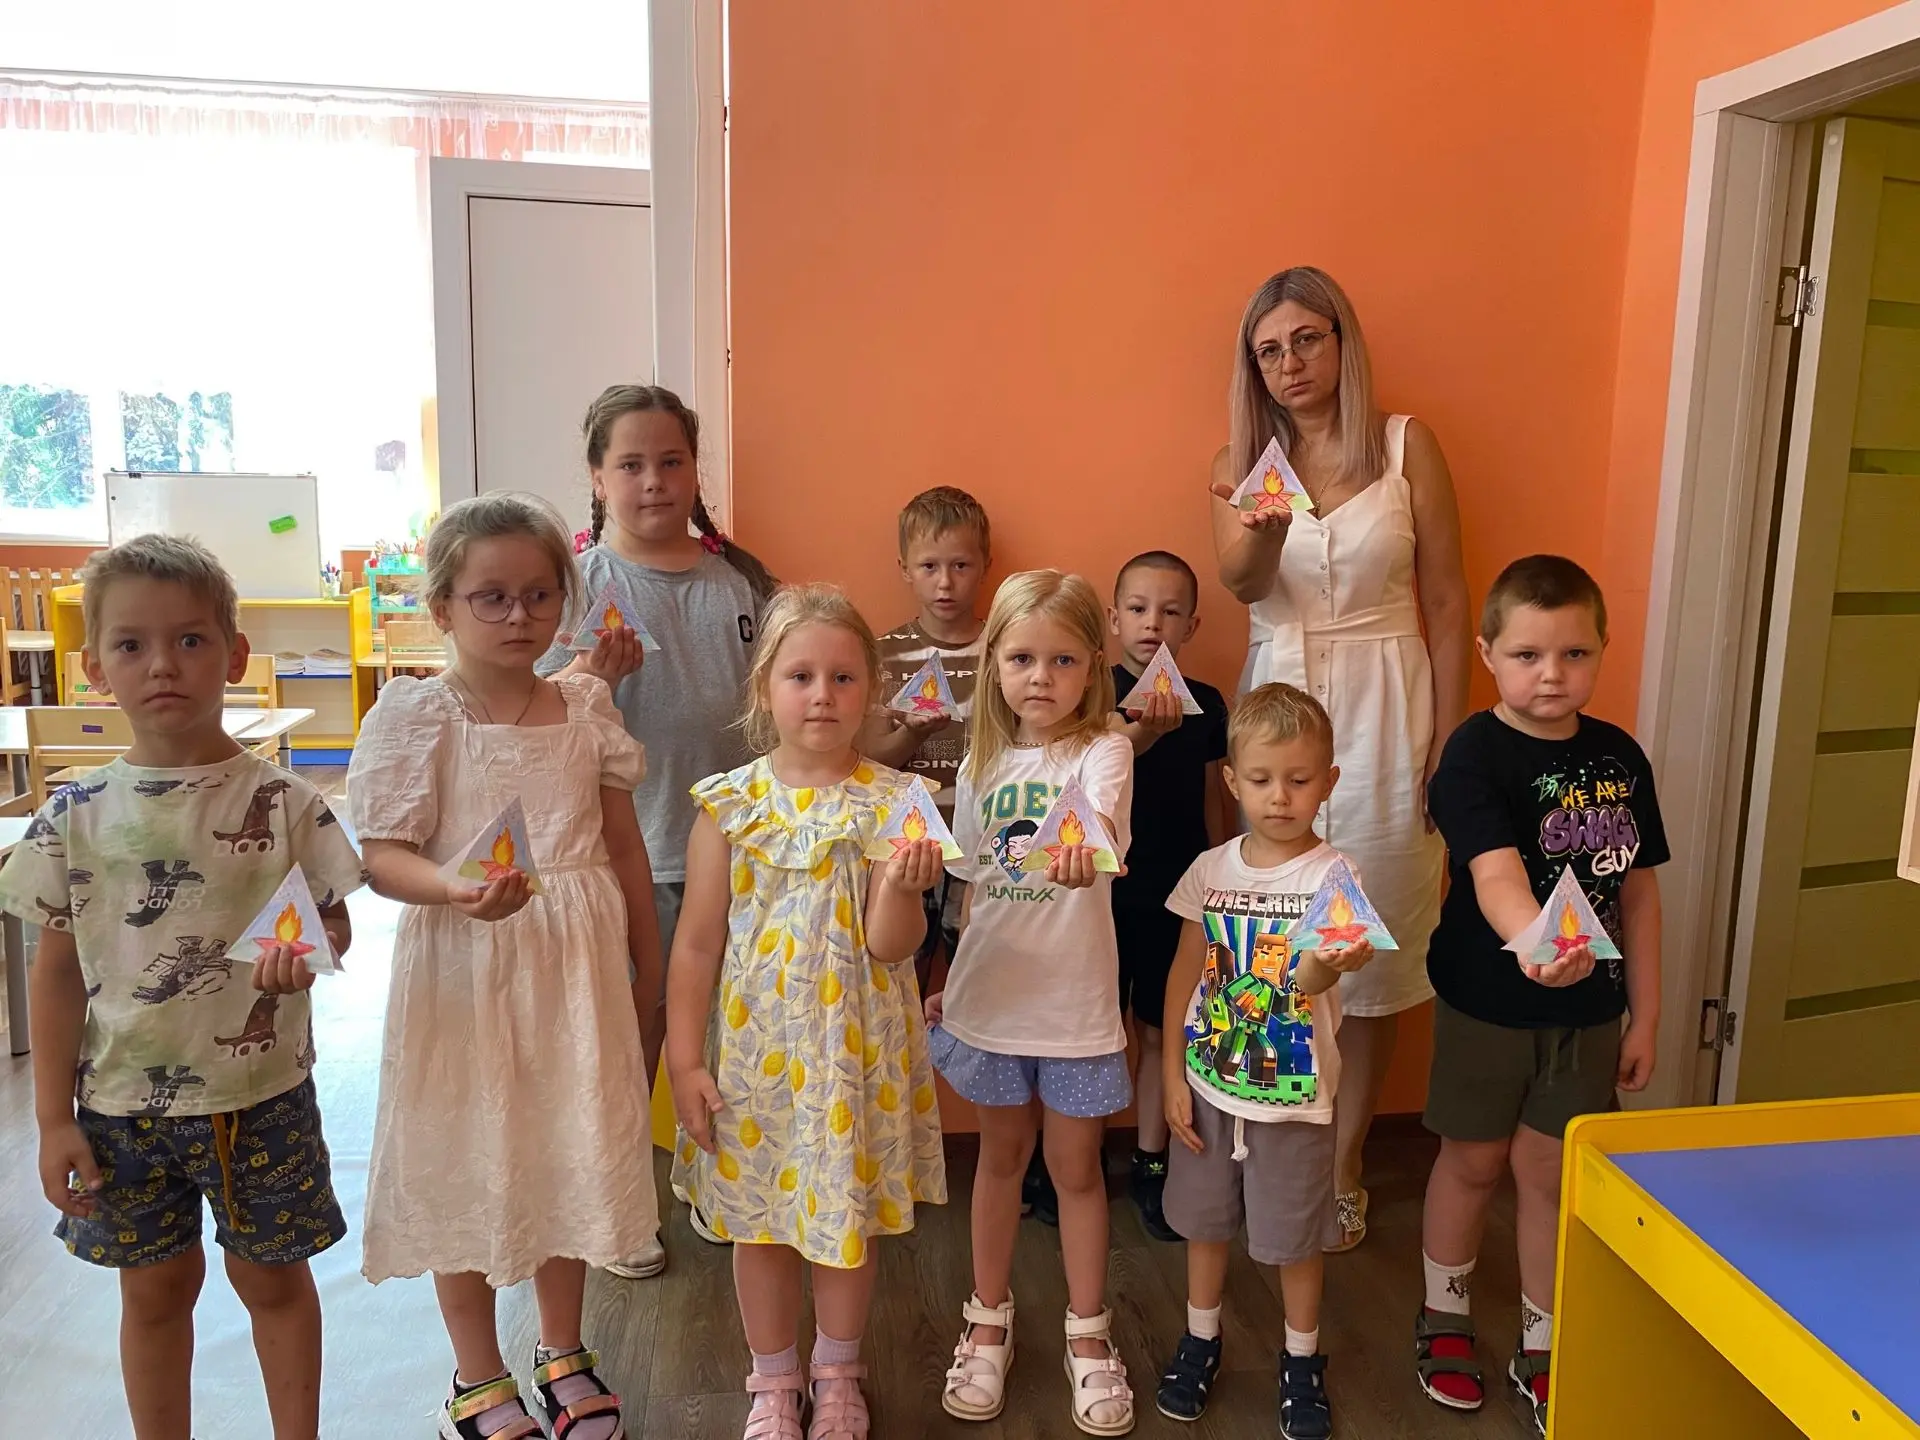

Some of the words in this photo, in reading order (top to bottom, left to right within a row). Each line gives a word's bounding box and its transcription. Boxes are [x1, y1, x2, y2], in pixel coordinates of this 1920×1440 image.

[908, 760, 958, 769] NIC
[1561, 784, 1590, 808] WE
[1595, 780, 1630, 803] ARE
[1539, 804, 1640, 857] SWAG
[1591, 843, 1640, 876] GUY
[1202, 887, 1318, 919] INECRAF
